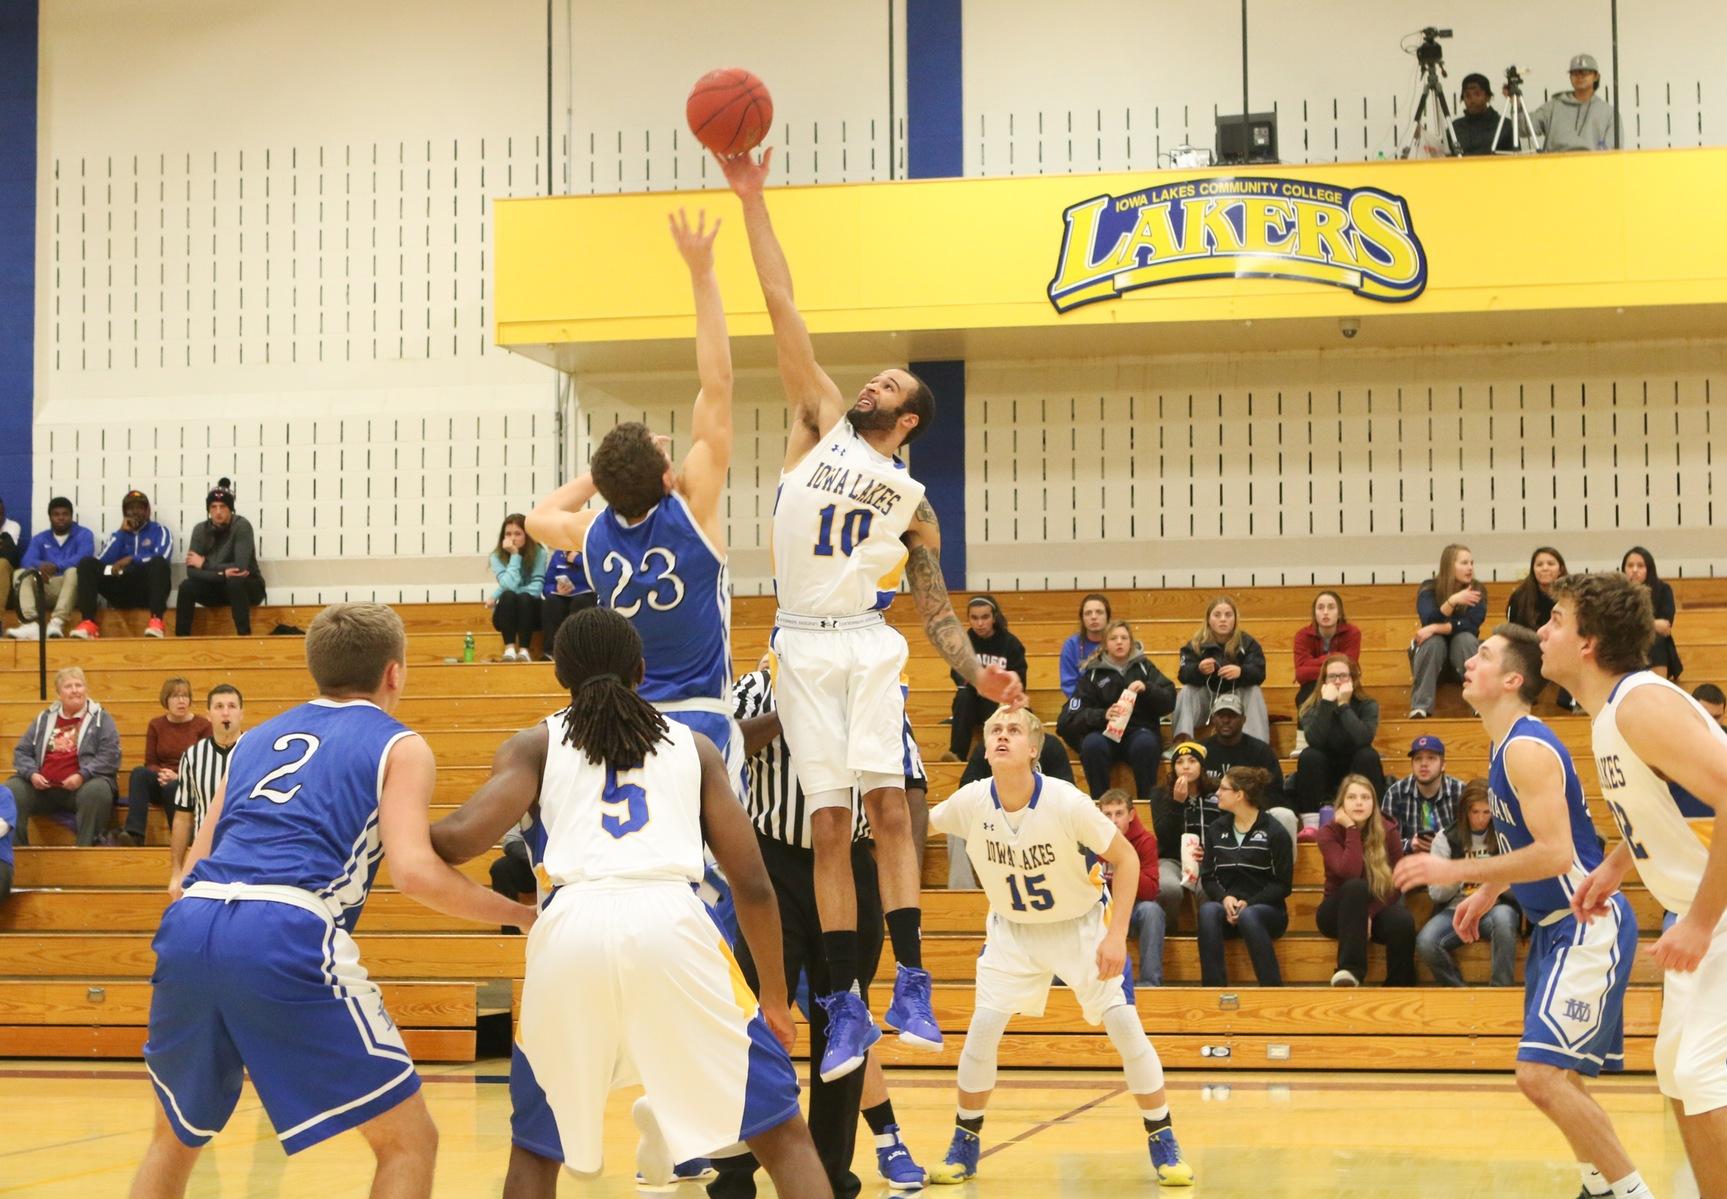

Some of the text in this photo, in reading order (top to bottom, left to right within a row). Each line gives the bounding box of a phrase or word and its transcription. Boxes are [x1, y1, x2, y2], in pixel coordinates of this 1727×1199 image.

[1115, 181, 1343, 213] IOWA LAKES COMMUNITY COLLEGE
[1050, 188, 1422, 297] LAKERS
[806, 462, 901, 516] IOWA LAKES
[813, 503, 875, 557] 10
[602, 546, 685, 619] 23
[247, 731, 321, 805] 2
[601, 756, 650, 840] 5
[986, 839, 1016, 868] IOWA
[1005, 873, 1056, 912] 15
